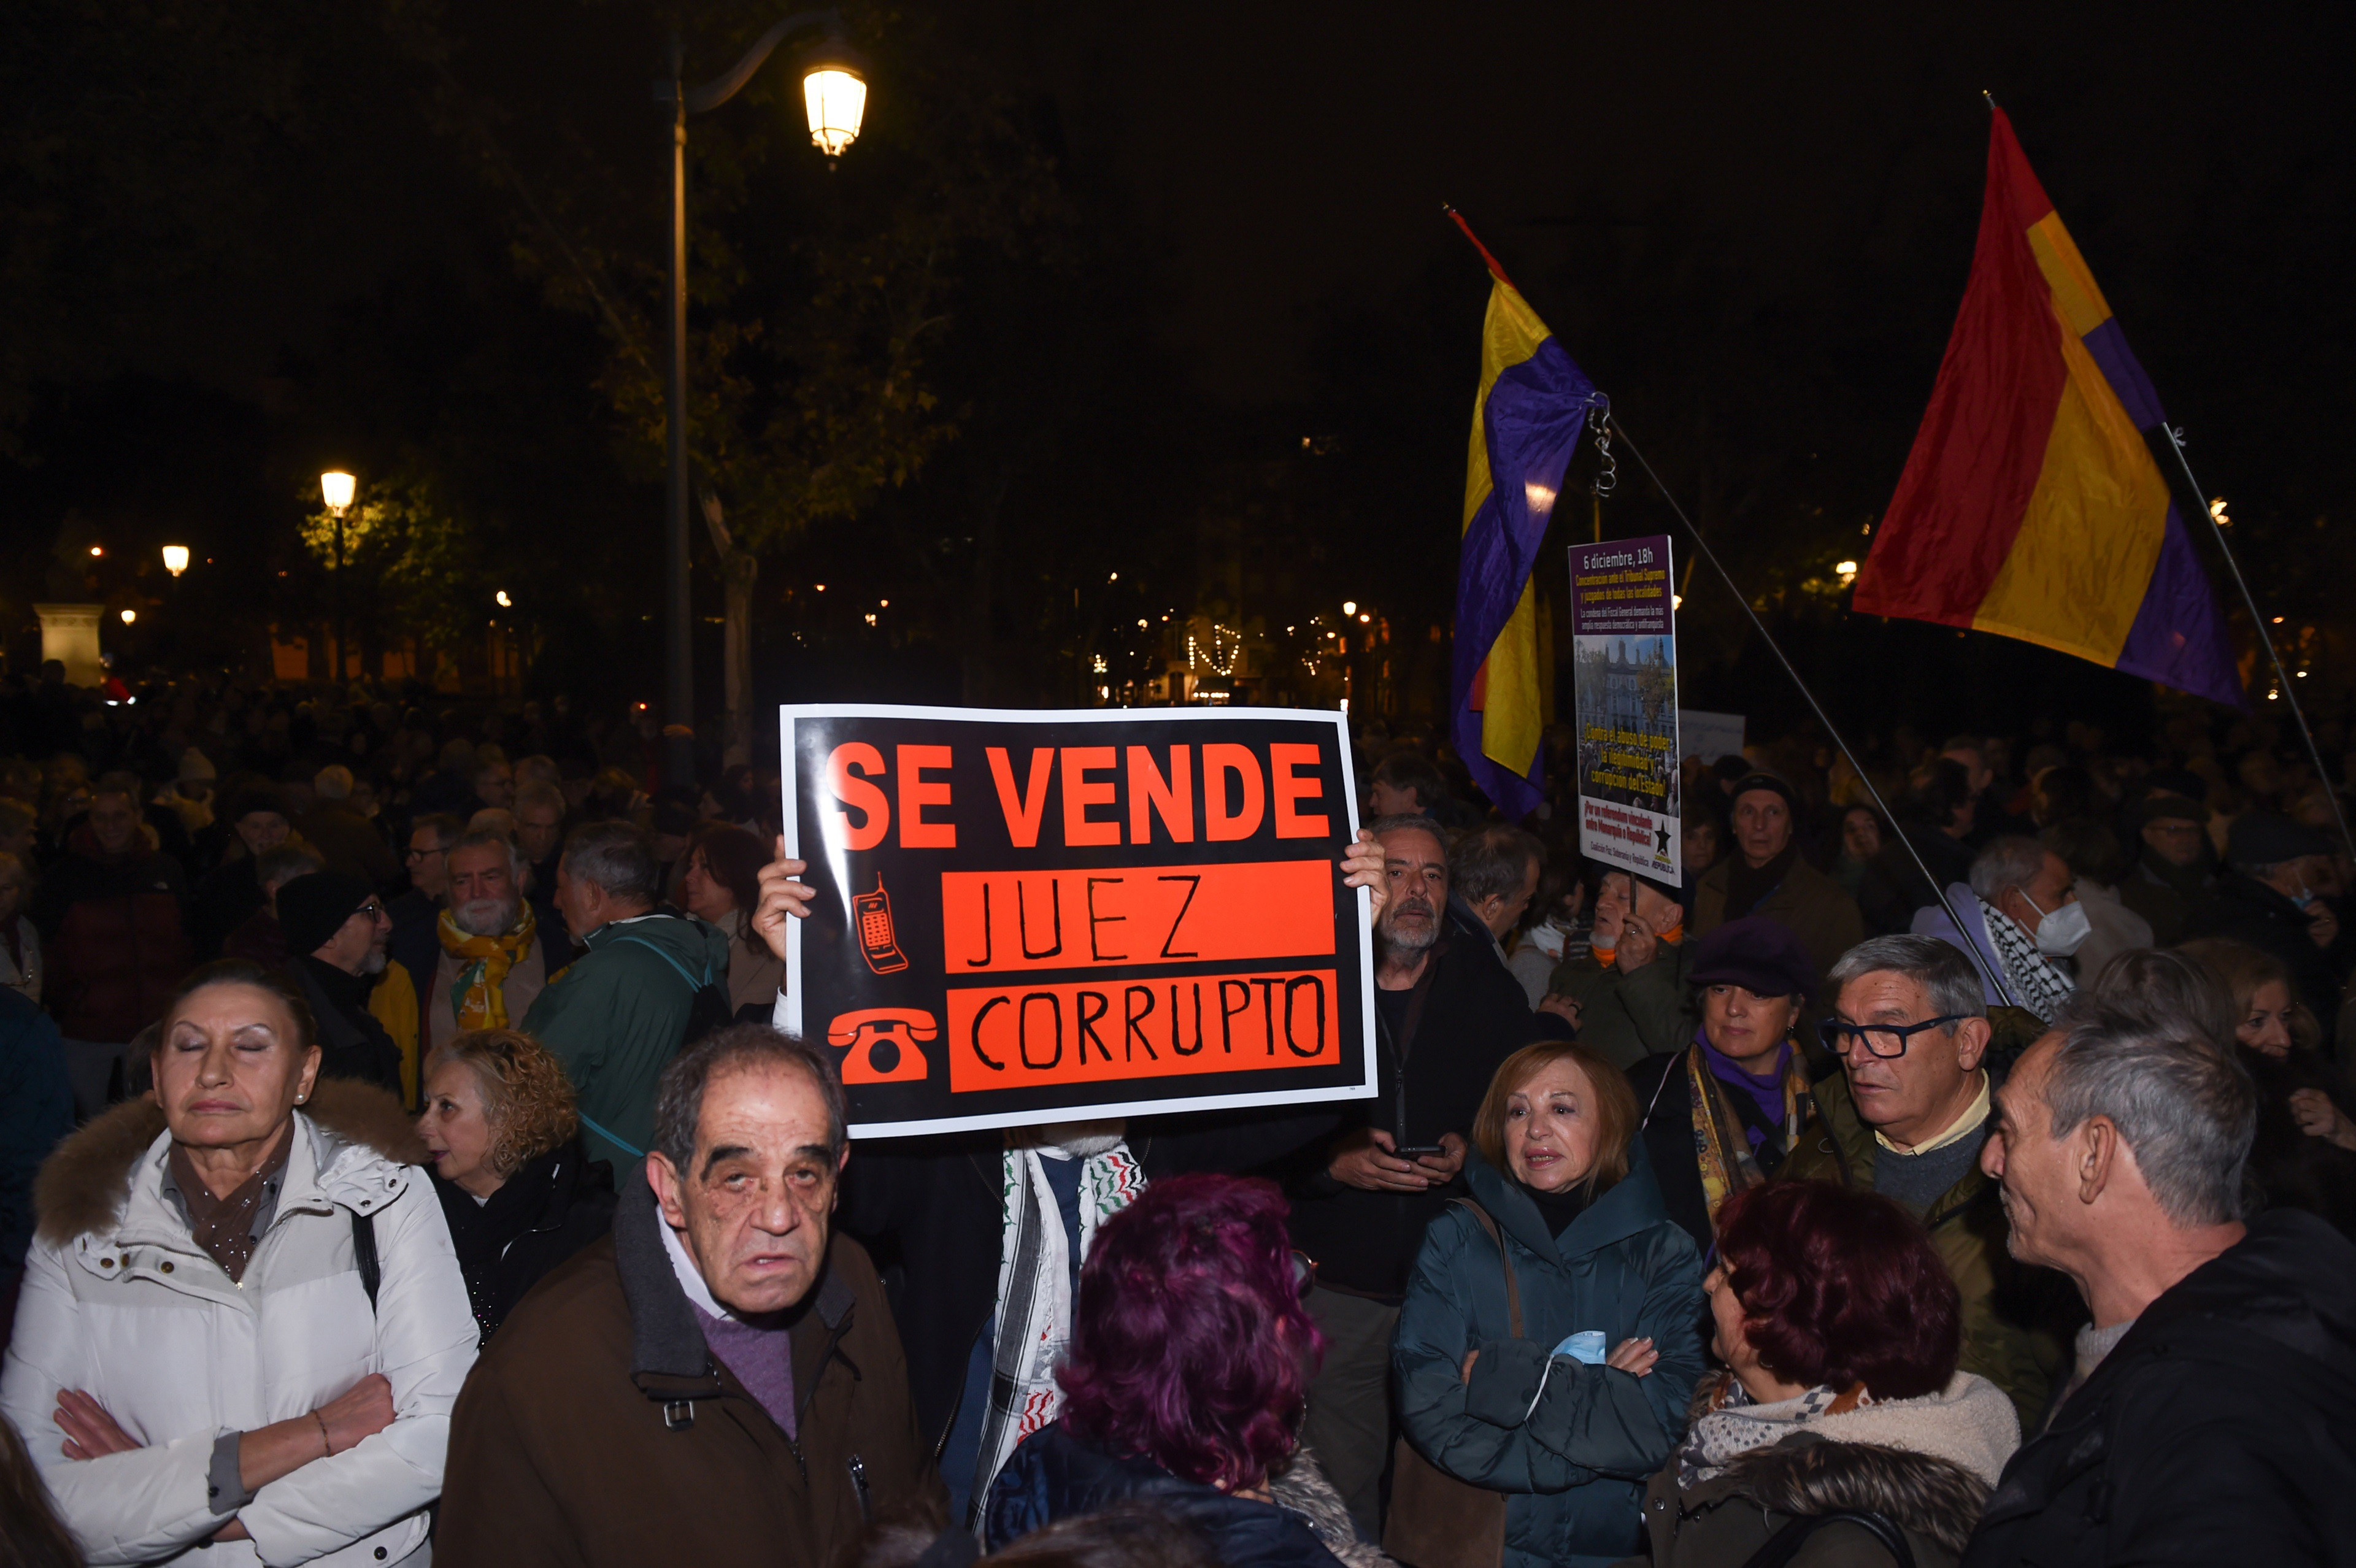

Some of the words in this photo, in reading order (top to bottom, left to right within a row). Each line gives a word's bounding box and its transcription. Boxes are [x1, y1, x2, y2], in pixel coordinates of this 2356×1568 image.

[1584, 555, 1590, 569] 6
[1592, 550, 1635, 569] diciembre,
[1638, 547, 1653, 564] 18h
[1609, 726, 1615, 742] el
[1617, 726, 1638, 745] abuso
[1639, 729, 1647, 747] de
[826, 742, 956, 850] SE
[985, 743, 1330, 848] VENDE
[968, 875, 1201, 967] JUEZ
[971, 974, 1325, 1071] CORRUPTO
